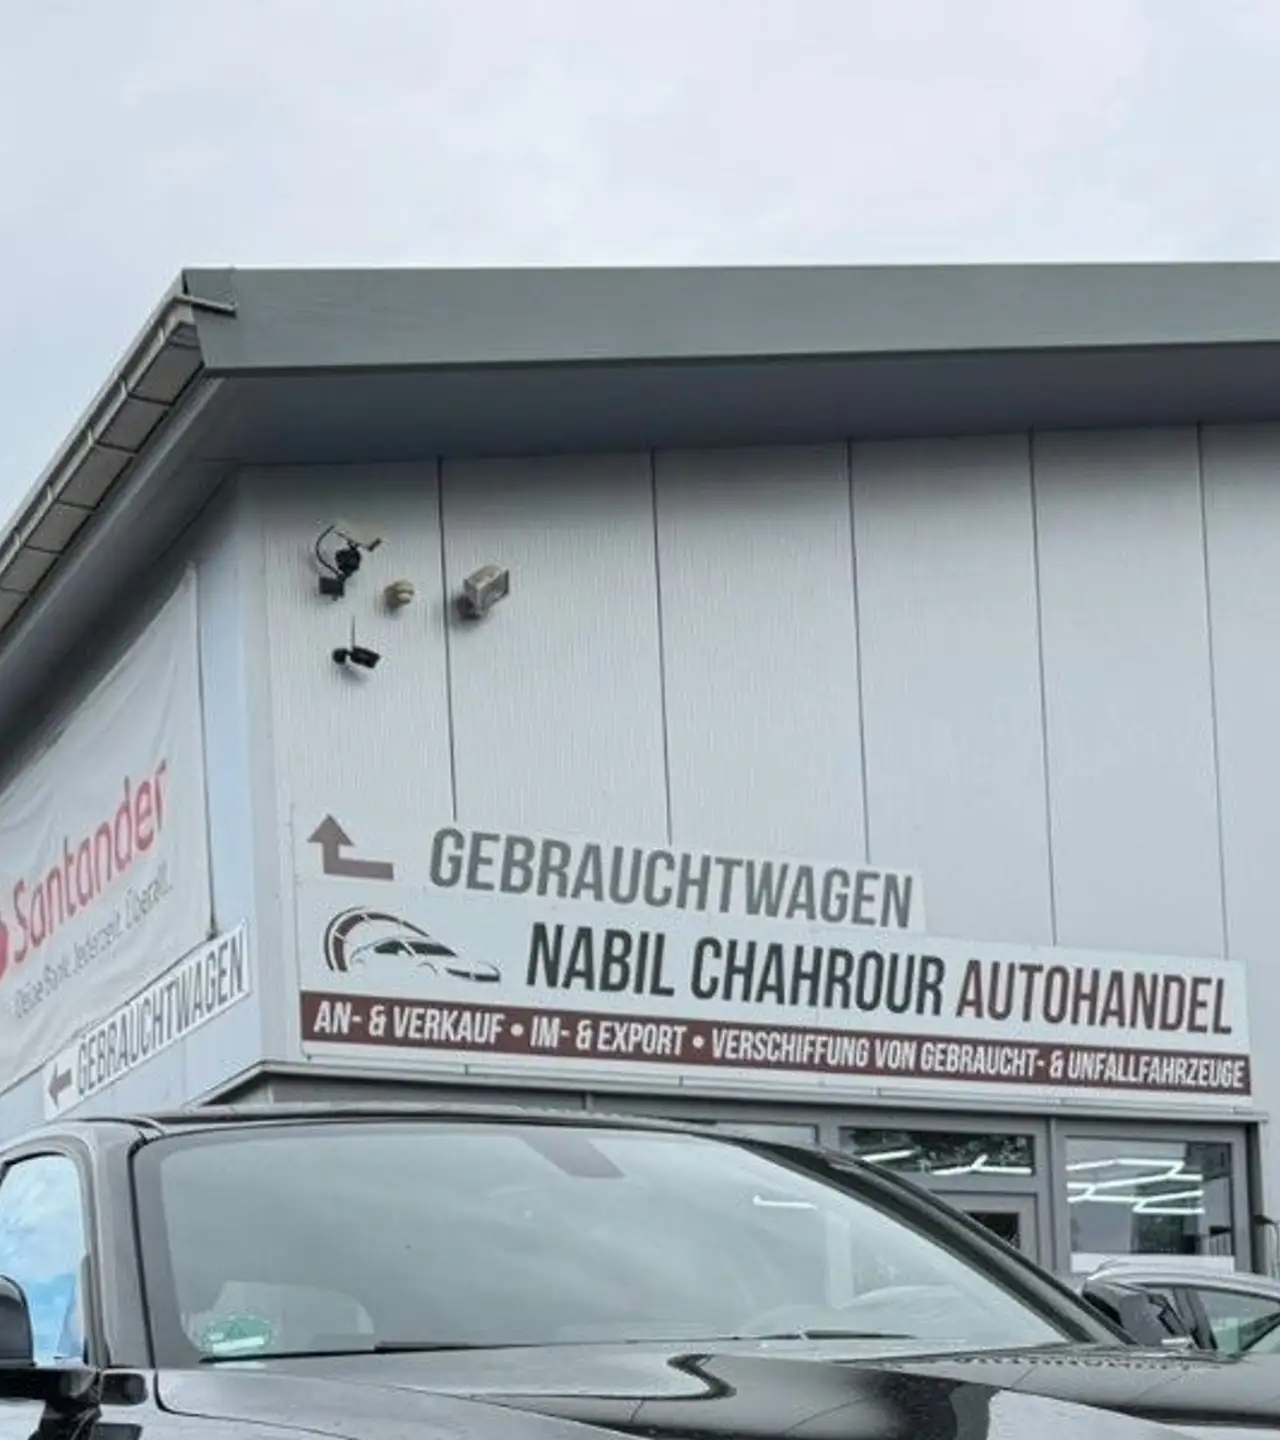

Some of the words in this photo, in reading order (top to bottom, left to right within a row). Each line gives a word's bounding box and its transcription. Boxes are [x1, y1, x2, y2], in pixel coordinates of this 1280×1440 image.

[13, 759, 168, 963] Santander
[429, 827, 910, 929] GEBRAUCHTWAGEN
[77, 930, 243, 1096] GEBRAUCHTWAGEN
[526, 921, 675, 997] NABIL
[690, 936, 947, 1016] CHAHROUR
[955, 958, 1233, 1036] AUTOHANDEL
[314, 1000, 362, 1035] AN-
[369, 1004, 388, 1038] &
[393, 1005, 506, 1044] VERKAUF
[530, 1015, 569, 1048] IM-
[575, 1019, 593, 1051] &
[596, 1020, 688, 1057] EXPORT
[711, 1027, 870, 1068] VERSCHIFFUNG
[874, 1037, 918, 1071] VON
[920, 1041, 1046, 1078] GEBRAUCHT-
[1049, 1049, 1064, 1079] &
[1068, 1051, 1245, 1090] UNFALLFAHRZEUGE
